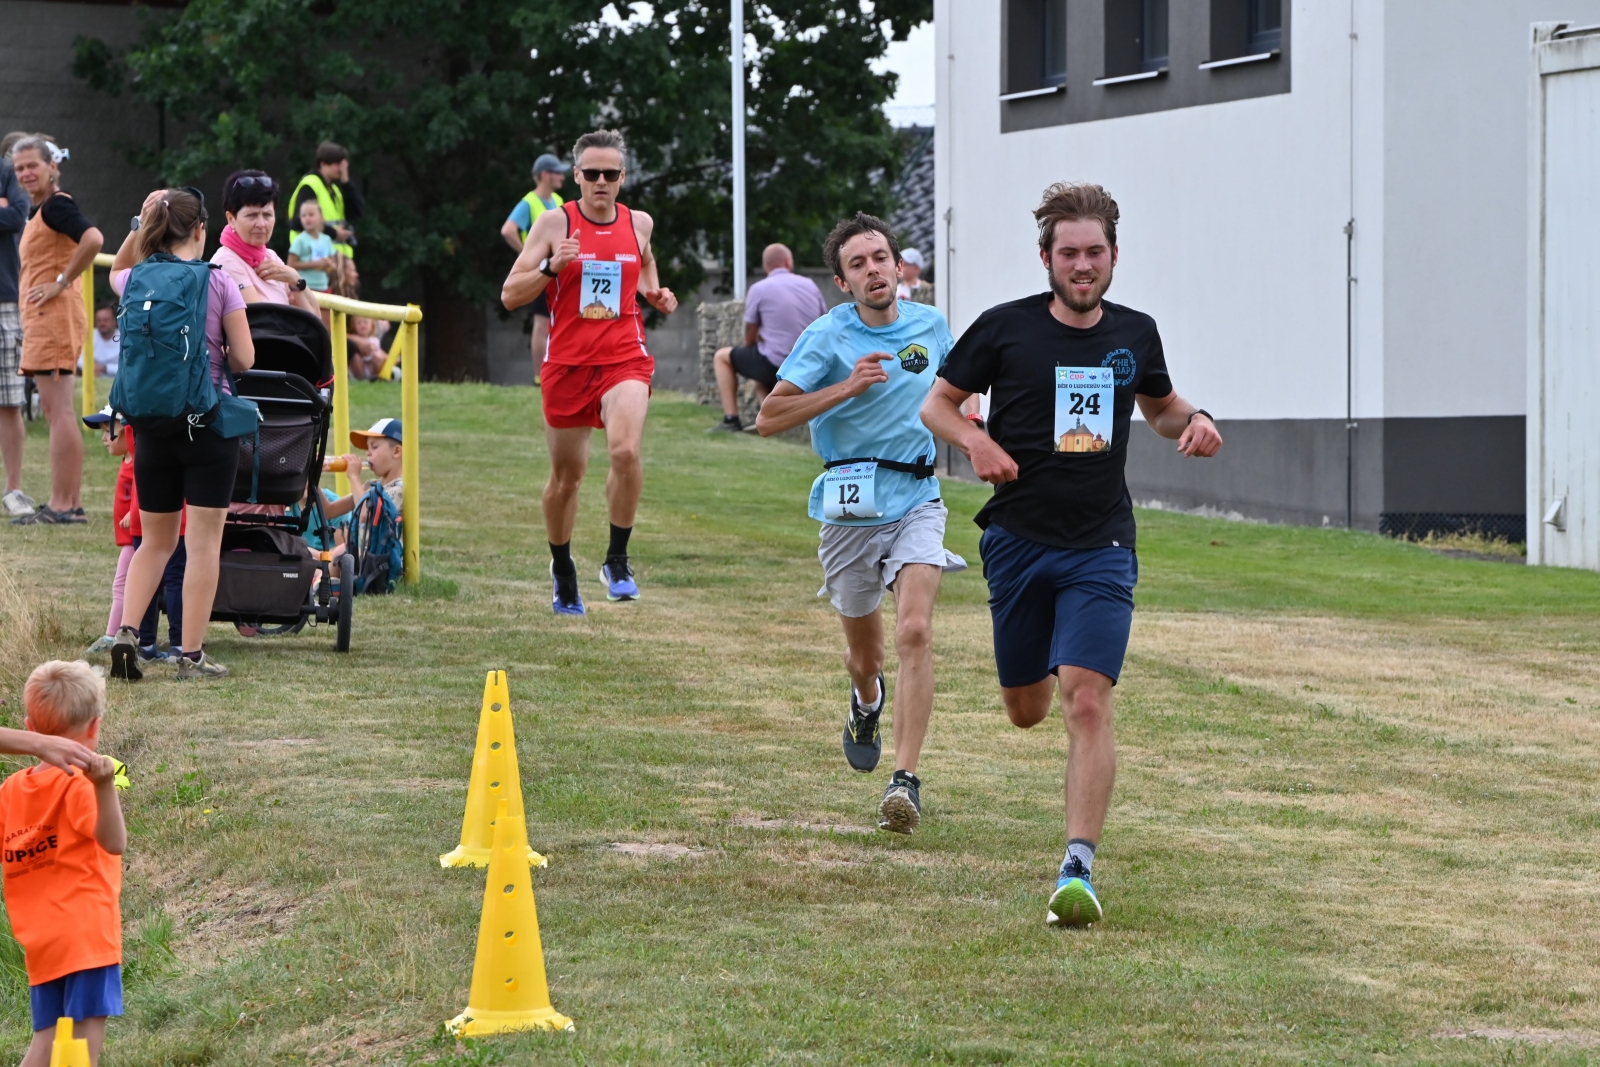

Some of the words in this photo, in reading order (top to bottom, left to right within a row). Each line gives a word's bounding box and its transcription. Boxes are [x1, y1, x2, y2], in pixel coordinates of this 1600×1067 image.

[592, 278, 611, 294] 72
[1069, 392, 1101, 415] 24
[839, 484, 859, 504] 12
